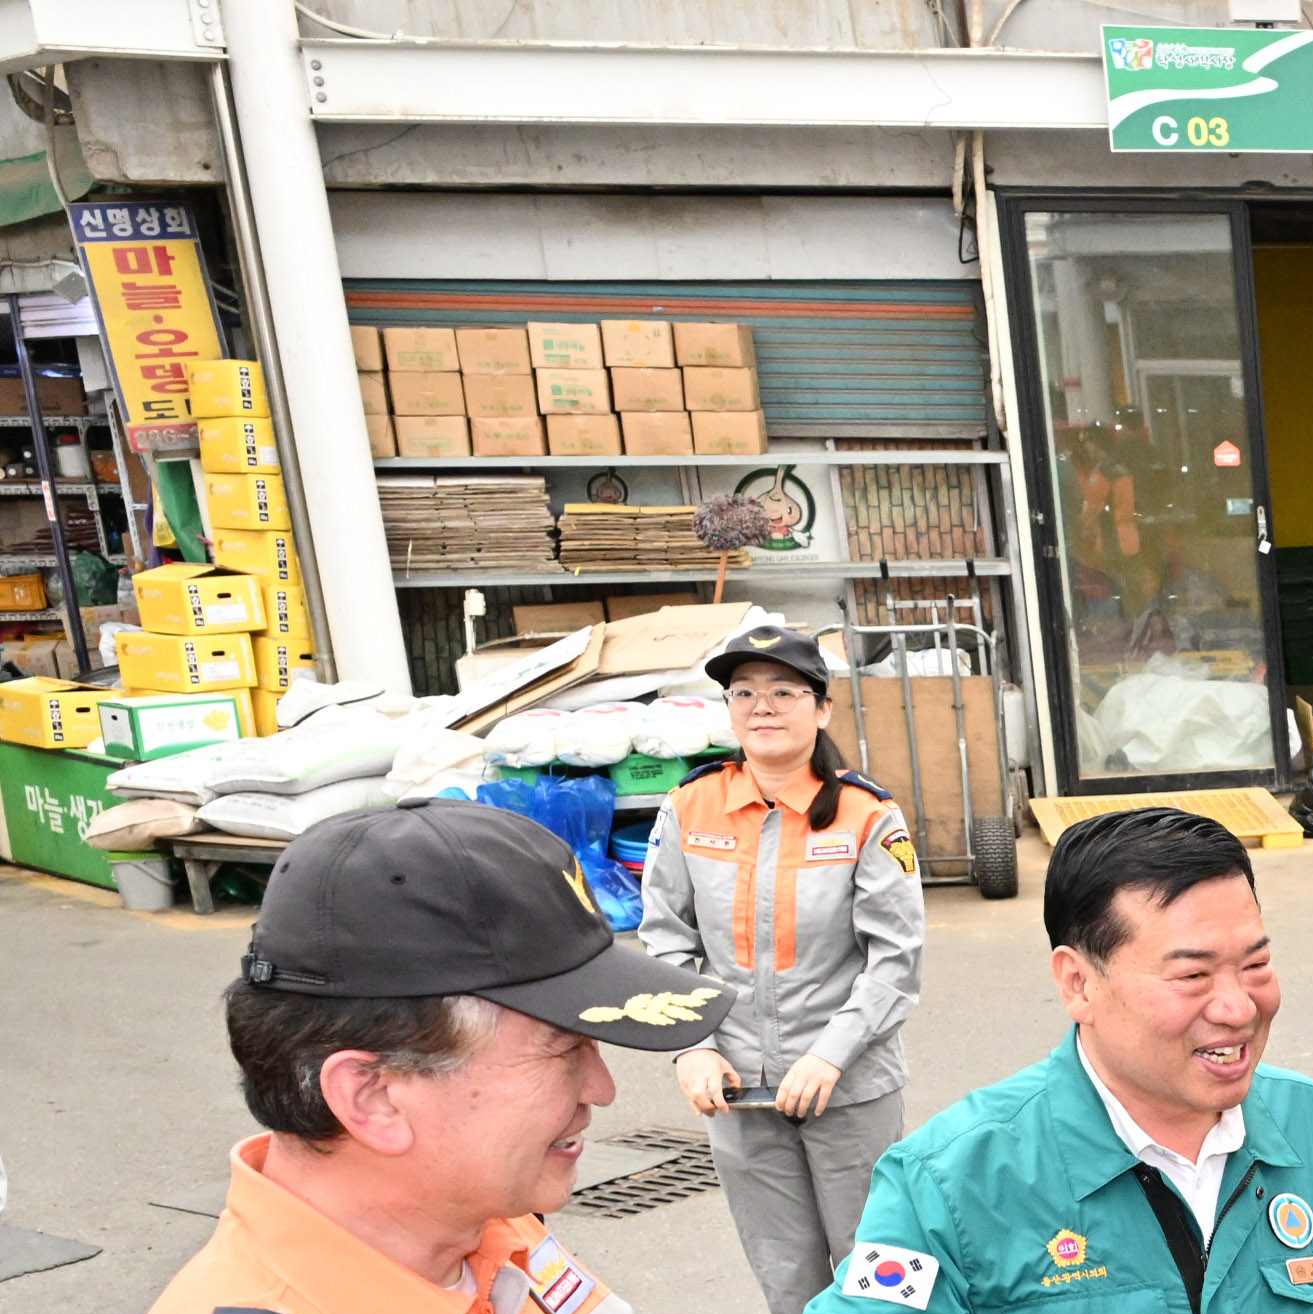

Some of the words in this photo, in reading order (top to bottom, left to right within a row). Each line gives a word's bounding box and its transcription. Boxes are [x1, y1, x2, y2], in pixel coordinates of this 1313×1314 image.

[1152, 116, 1179, 146] C
[1187, 116, 1230, 147] 03
[80, 207, 191, 238] 신명상회
[1057, 1241, 1079, 1256] 의회
[1040, 1265, 1108, 1287] 울산광역시의회
